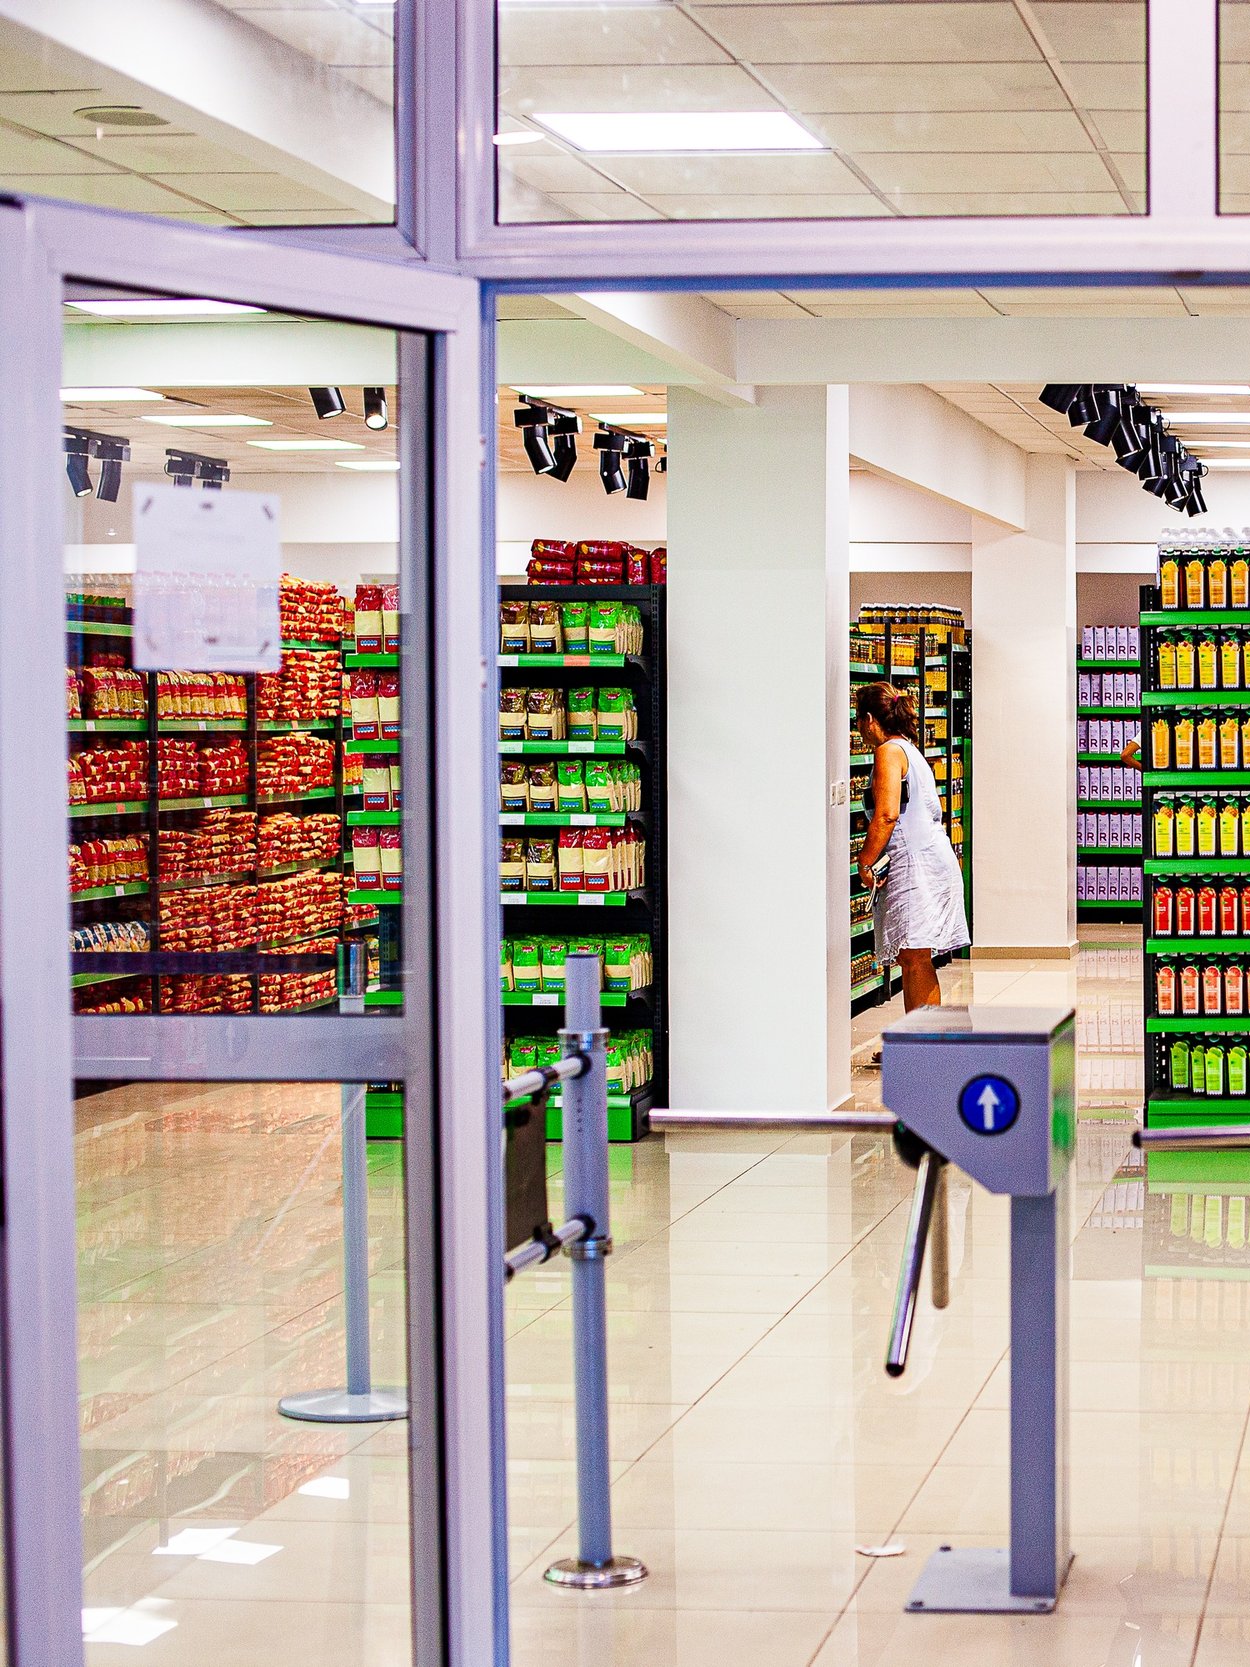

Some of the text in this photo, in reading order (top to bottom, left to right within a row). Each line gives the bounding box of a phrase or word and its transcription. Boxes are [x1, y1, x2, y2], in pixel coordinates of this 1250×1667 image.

[1084, 646, 1092, 654] R
[1096, 646, 1104, 654] R
[1108, 646, 1115, 654] R
[1119, 646, 1126, 654] R
[1130, 646, 1137, 654] R
[1081, 692, 1088, 701] R
[1092, 692, 1100, 701] R
[1104, 692, 1112, 701] R
[1116, 692, 1123, 701] R
[1128, 692, 1134, 701] R
[1079, 739, 1086, 748] R
[1090, 739, 1098, 748] R
[1101, 739, 1108, 748] R
[1113, 739, 1120, 748] R
[1080, 786, 1086, 794] R
[1092, 786, 1098, 794] R
[1102, 786, 1109, 794] R
[1114, 786, 1121, 794] R
[1126, 786, 1132, 794] R
[1087, 832, 1094, 841] R
[1100, 832, 1107, 841] R
[1112, 832, 1119, 841] R
[1123, 832, 1130, 841] R
[1134, 832, 1142, 841] R
[1088, 886, 1095, 894] R
[1099, 886, 1106, 894] R
[1110, 886, 1117, 894] R
[1121, 886, 1128, 894] R
[1132, 886, 1139, 894] R
